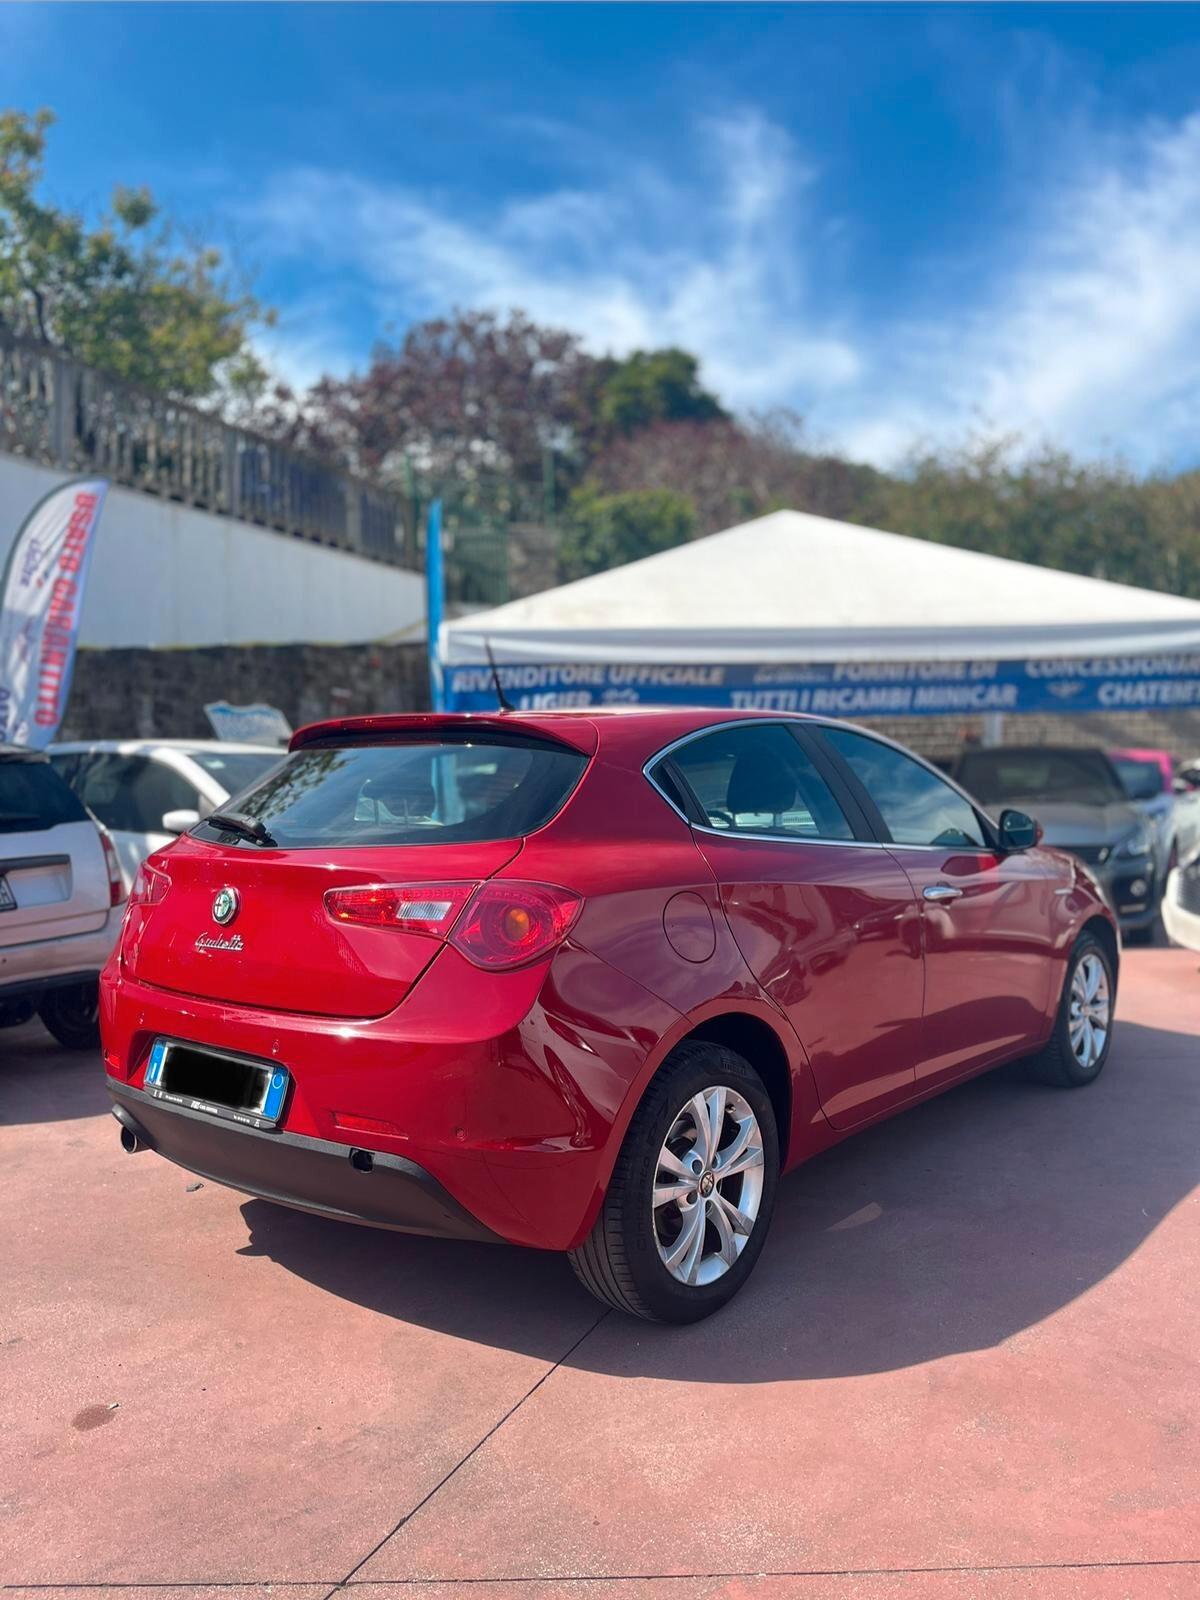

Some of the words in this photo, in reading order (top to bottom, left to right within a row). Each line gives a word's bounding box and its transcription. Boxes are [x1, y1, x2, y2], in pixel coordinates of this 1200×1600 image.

[34, 577, 78, 727] GARANTITO
[452, 666, 605, 692] RIVENDITORE
[607, 665, 725, 686] UFFICIALE
[730, 690, 797, 710] TUTTI
[811, 687, 912, 711] RICAMBI
[914, 684, 1017, 707] MINICAR
